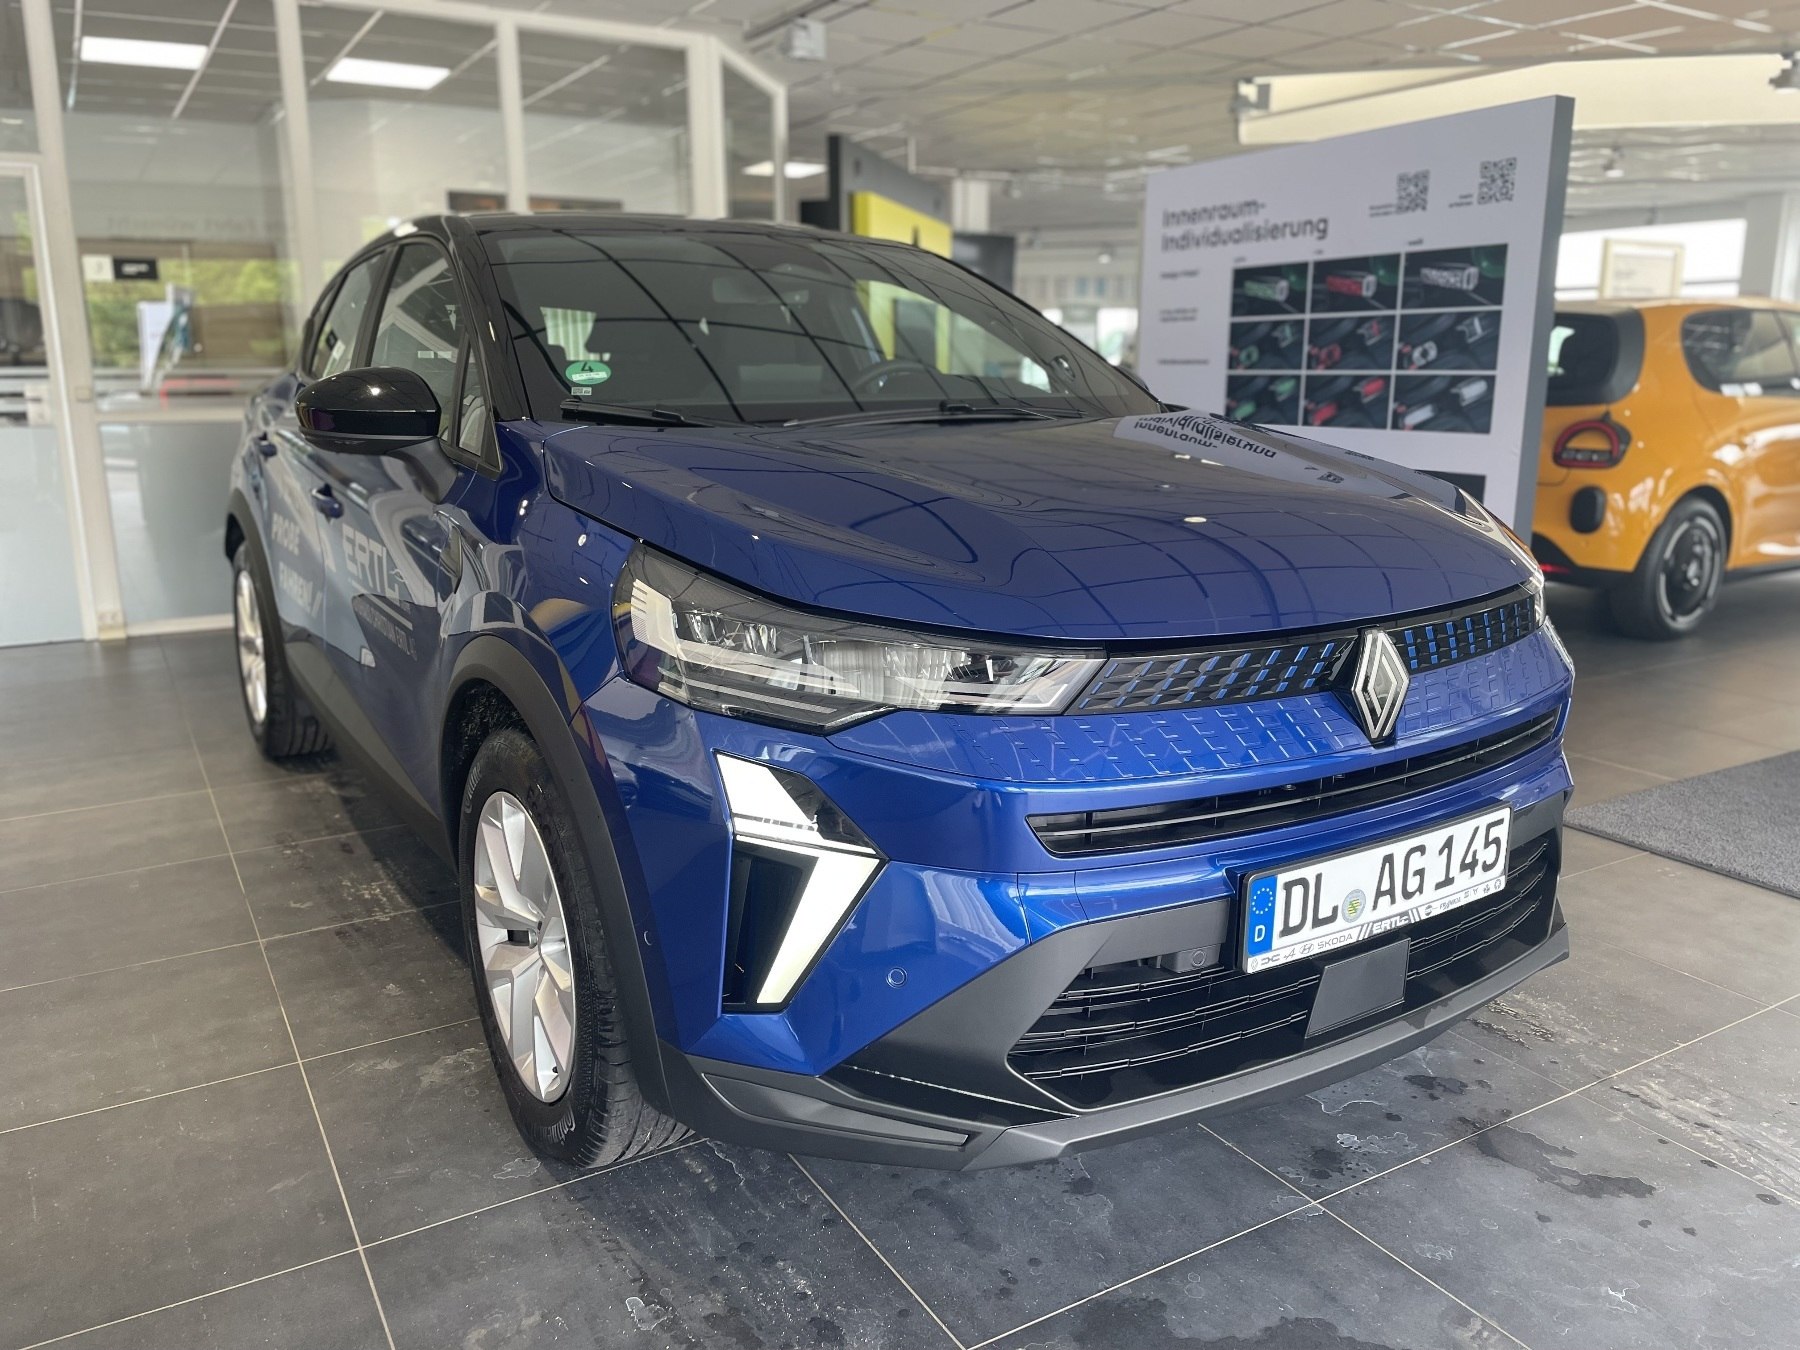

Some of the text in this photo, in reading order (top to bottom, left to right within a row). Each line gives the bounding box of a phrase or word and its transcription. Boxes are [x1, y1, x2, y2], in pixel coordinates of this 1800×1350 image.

[1162, 200, 1266, 228] Innenraum-
[1161, 217, 1329, 252] Individualisierung
[1279, 817, 1505, 938] DL AG 145
[1254, 924, 1266, 943] D
